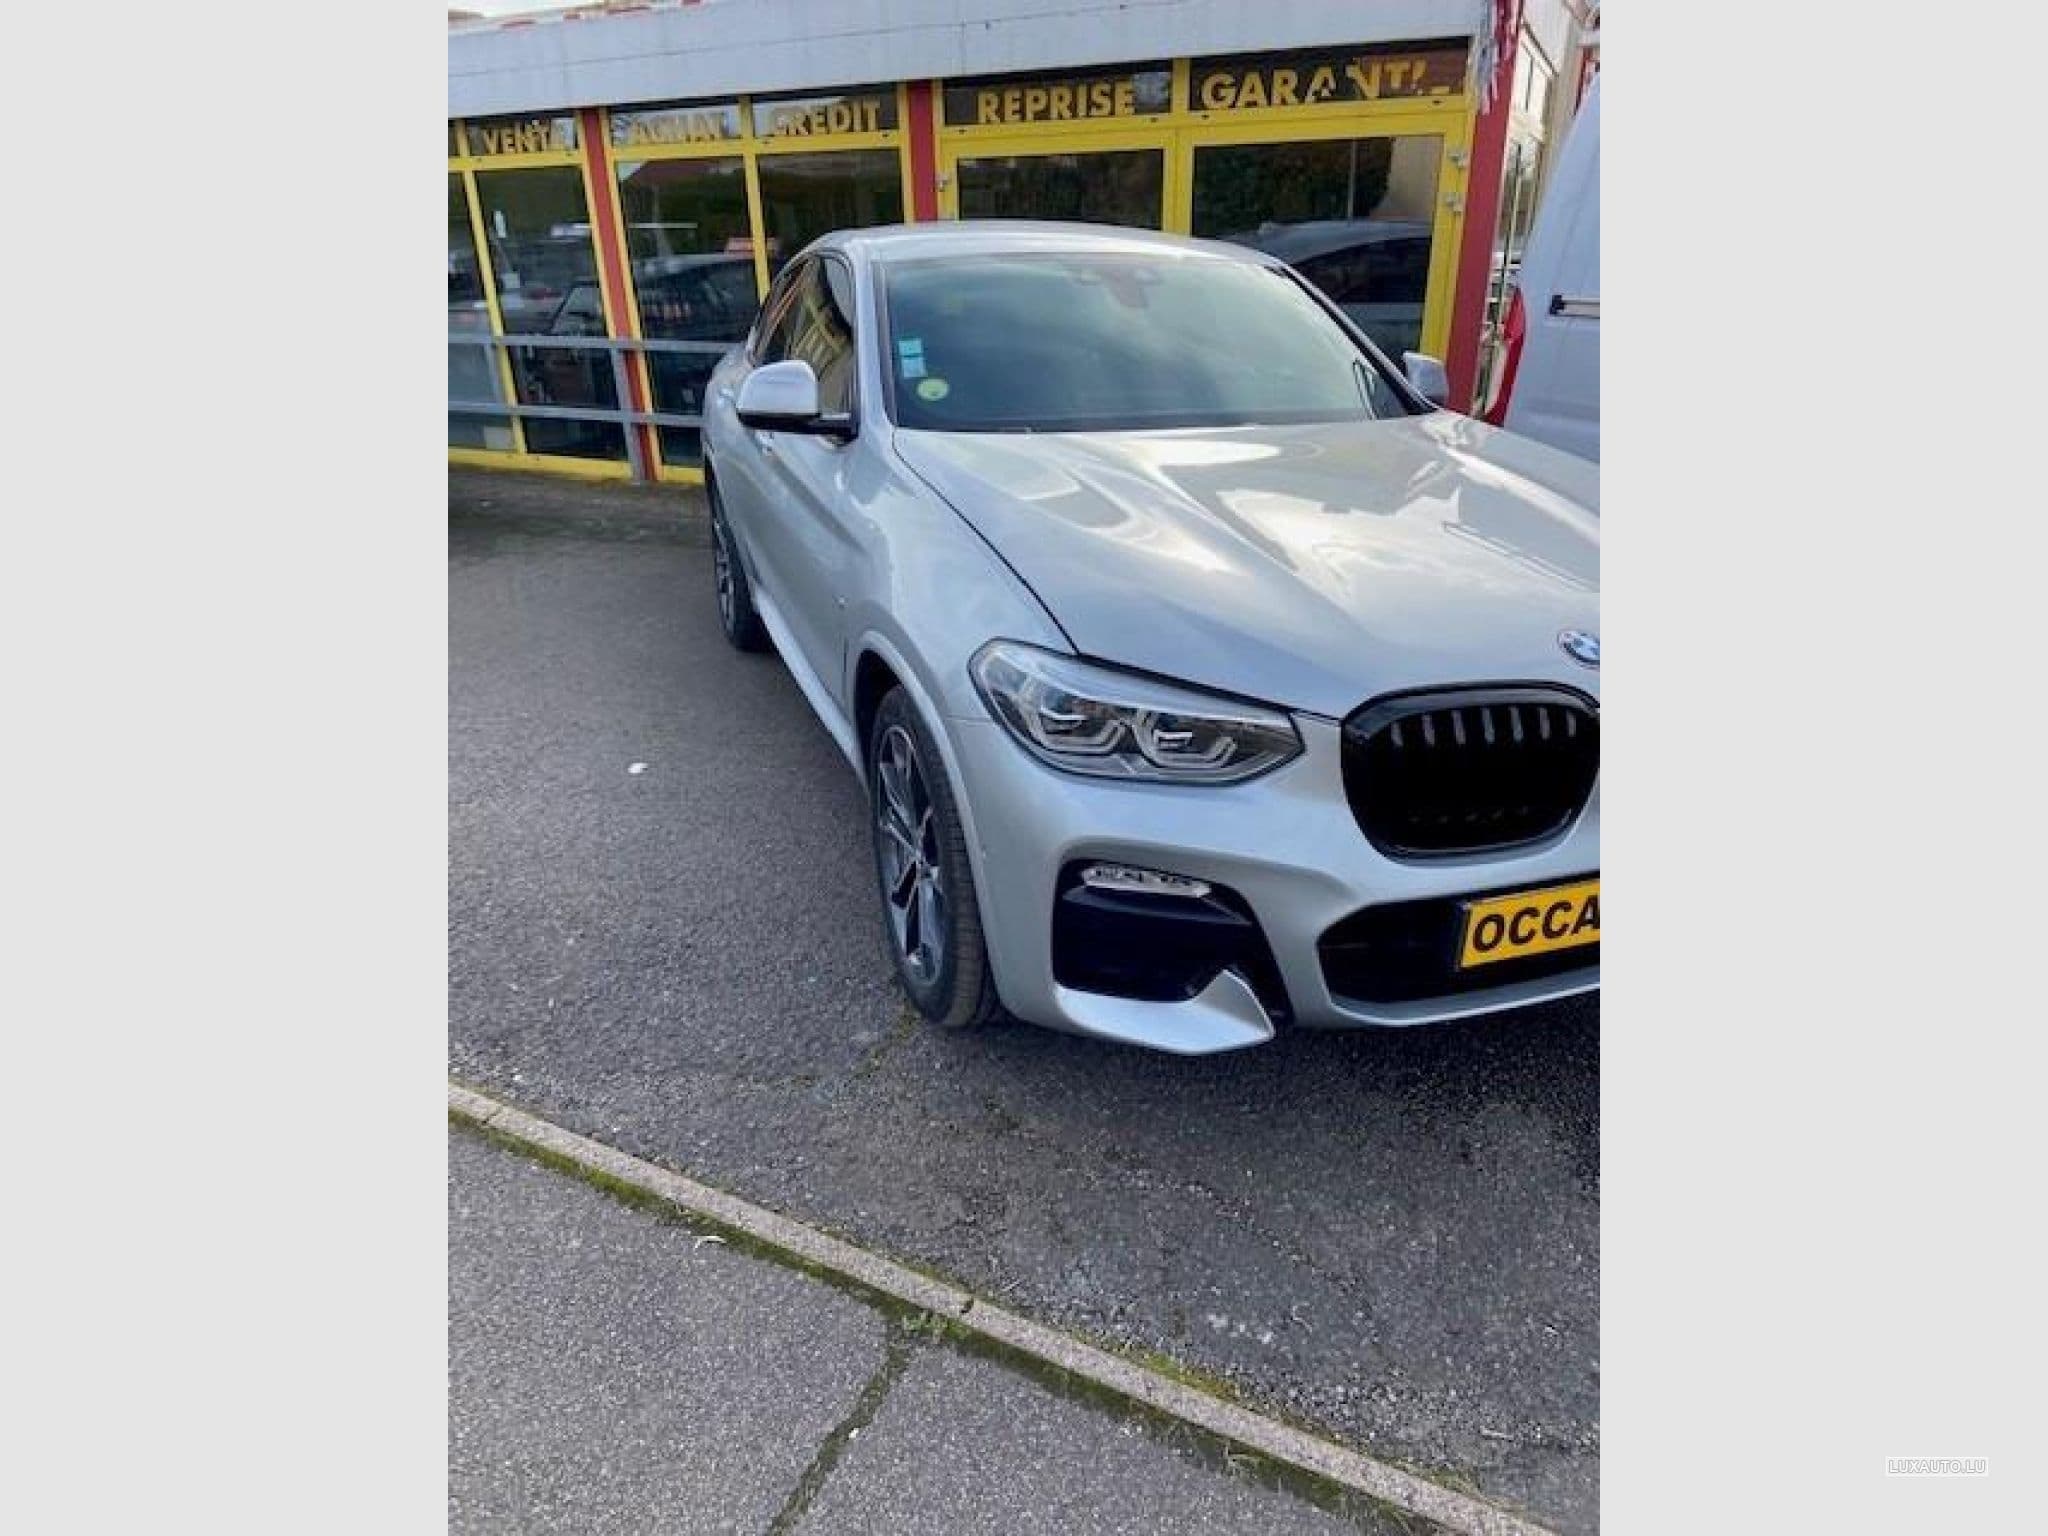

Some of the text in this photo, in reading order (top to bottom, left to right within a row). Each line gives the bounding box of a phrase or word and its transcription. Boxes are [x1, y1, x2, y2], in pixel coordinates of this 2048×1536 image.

[978, 77, 1135, 123] REPRISE
[1201, 57, 1450, 109] GARANTI
[1472, 894, 1600, 952] OCCA
